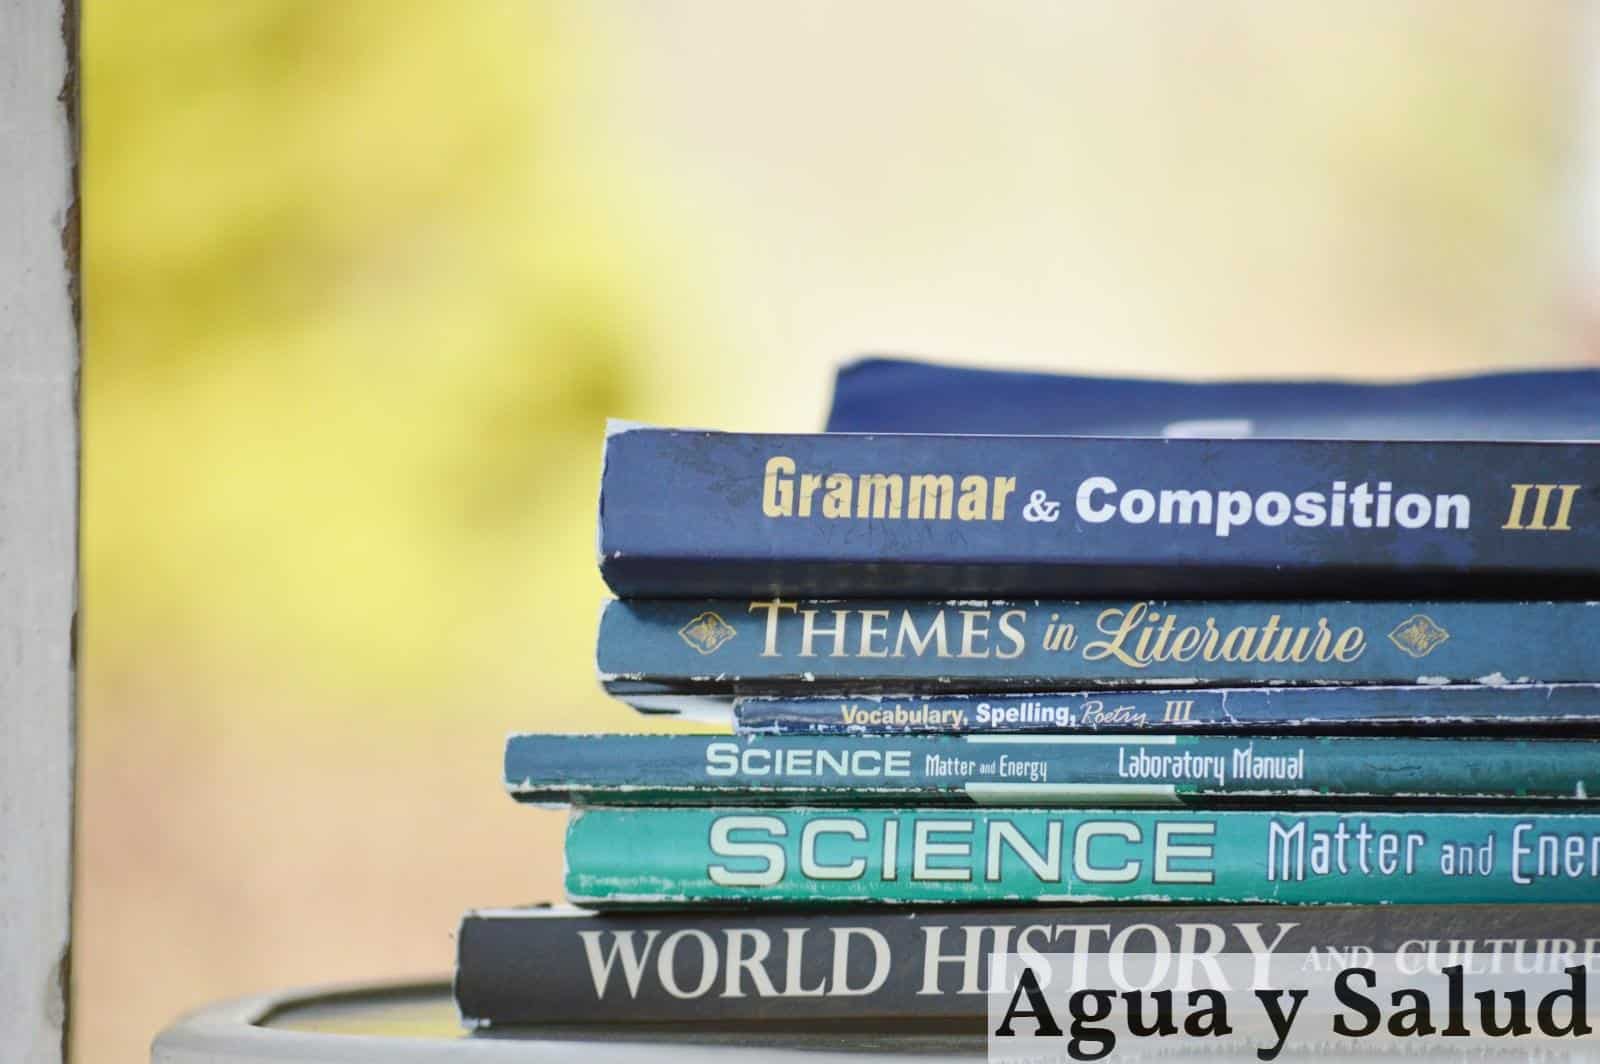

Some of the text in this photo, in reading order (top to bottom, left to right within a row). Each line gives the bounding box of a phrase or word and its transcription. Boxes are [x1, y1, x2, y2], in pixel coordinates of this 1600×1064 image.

[762, 456, 1581, 537] Grammar & Composition III
[1042, 613, 1078, 652] in
[1082, 602, 1367, 669] Literature
[840, 700, 1194, 729] Vocabulary, Spelling, Poetry III
[706, 743, 1304, 786] SCIENCE Matter and Energy Laboratory Manual
[708, 816, 1216, 887] SCIENCE
[1267, 820, 1424, 882] Matter
[1440, 835, 1494, 876] and
[578, 926, 892, 1001] WORLD
[916, 921, 1299, 998] HISTORY
[1301, 945, 1376, 973] AND
